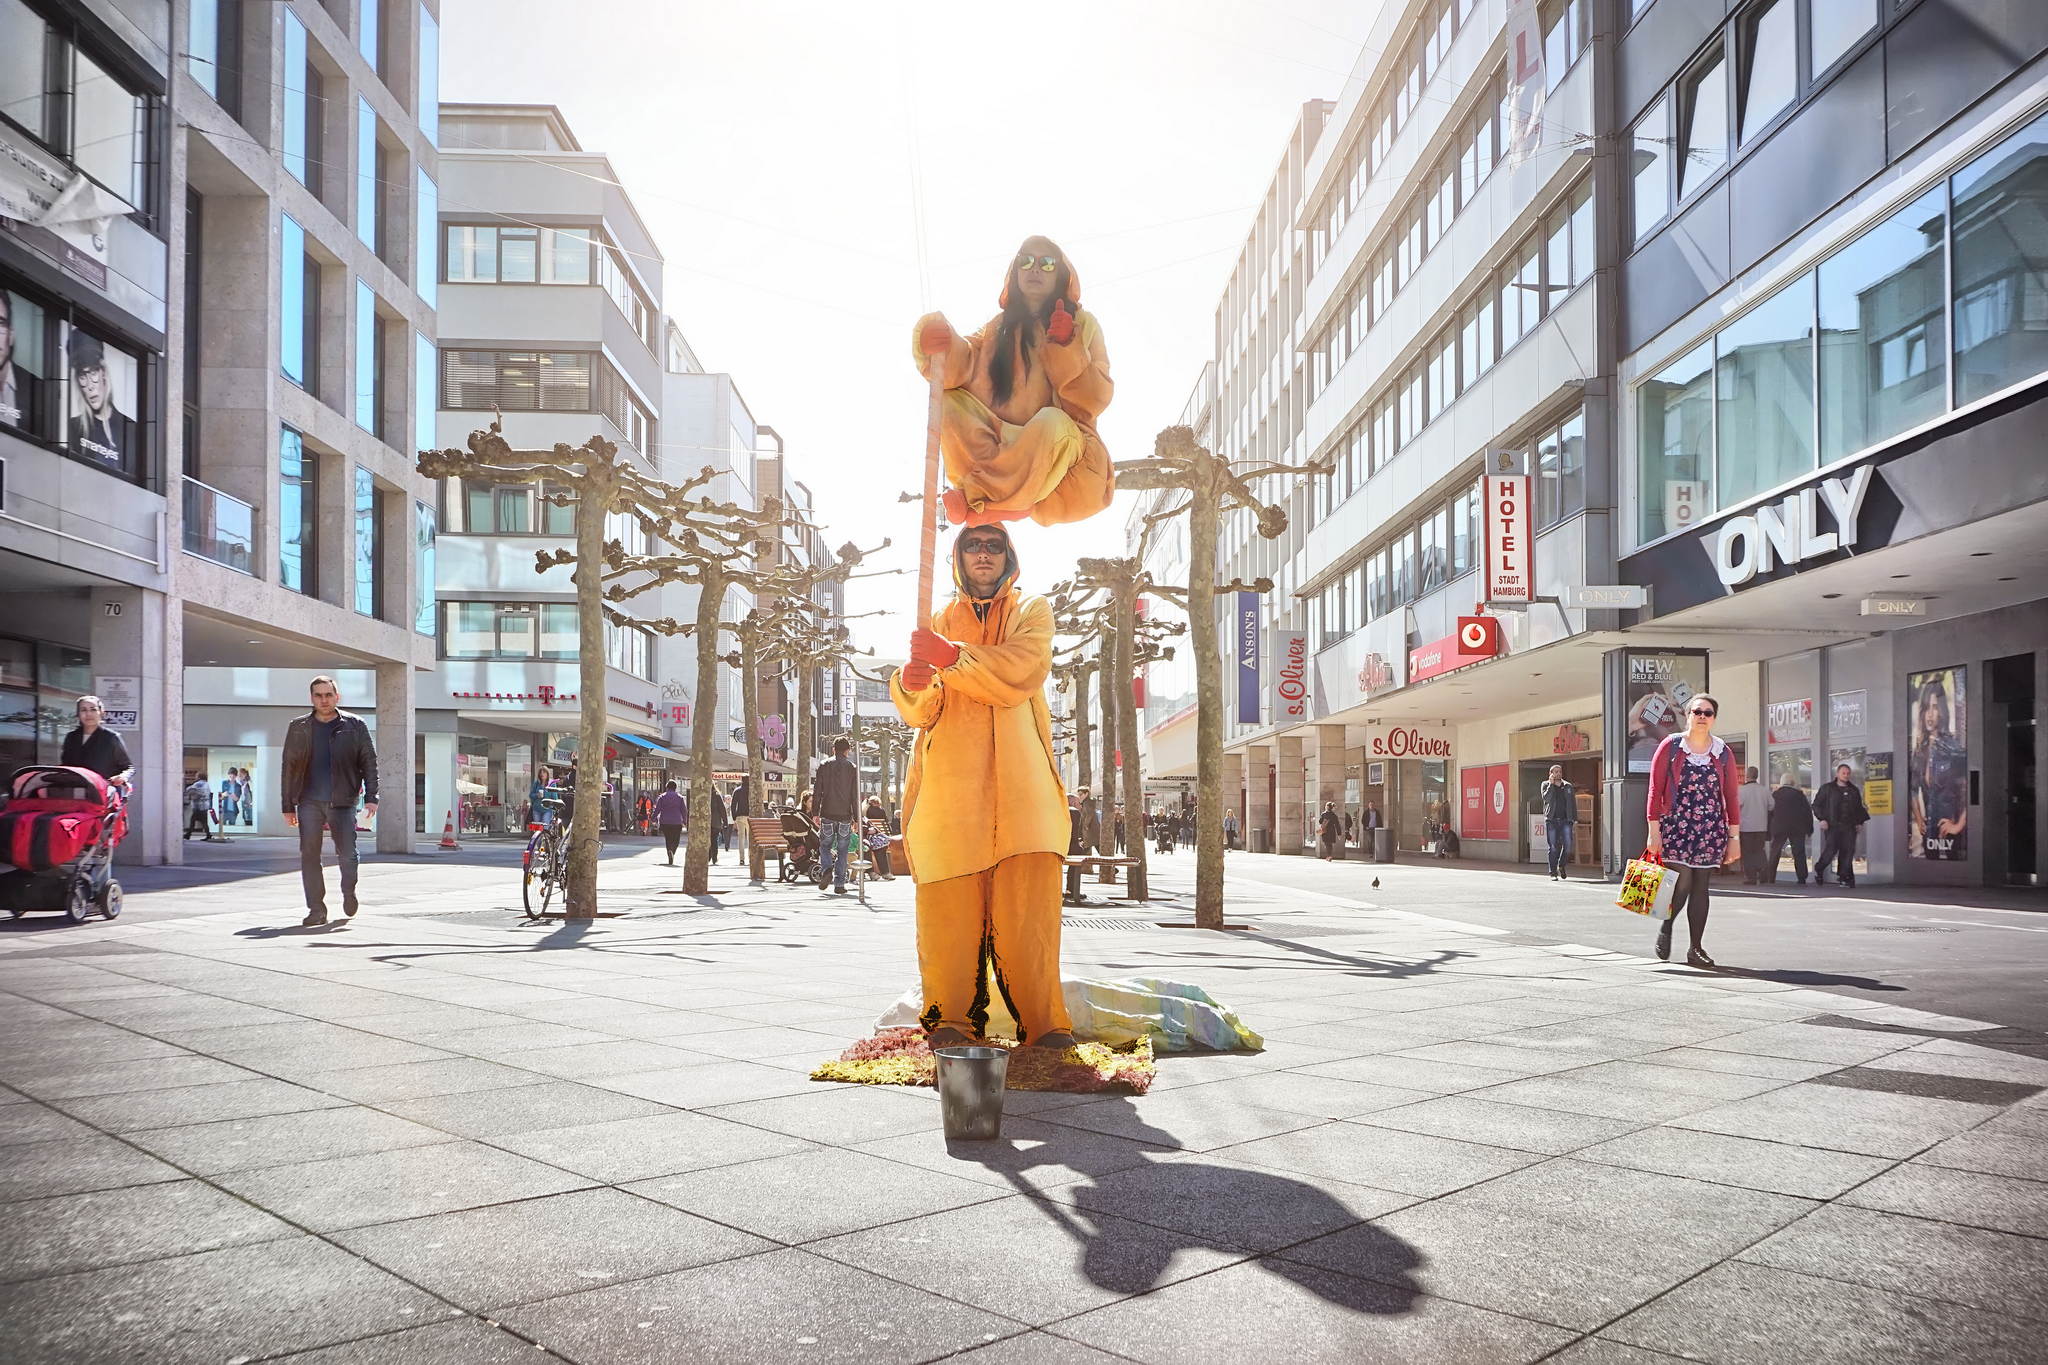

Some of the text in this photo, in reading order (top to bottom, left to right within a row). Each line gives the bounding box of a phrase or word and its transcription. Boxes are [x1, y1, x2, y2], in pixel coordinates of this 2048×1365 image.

[1499, 481, 1515, 571] HOTEL
[1717, 464, 1875, 585] ONLY
[1498, 575, 1520, 585] STADT
[1493, 586, 1526, 596] HAMBURG
[1579, 590, 1631, 603] ONLY
[105, 603, 121, 615] 70
[1878, 602, 1917, 613] ONLY
[1241, 610, 1256, 670] ANSON'S
[1418, 650, 1441, 670] vodafone
[1631, 659, 1674, 673] NEW
[1278, 637, 1306, 716] s.Oliver
[1654, 673, 1673, 681] BLUE
[538, 685, 555, 705] T
[672, 706, 687, 723] T
[1768, 701, 1808, 727] HOTEL
[1373, 727, 1452, 757] s.Oliver
[1926, 838, 1954, 850] ONLY
